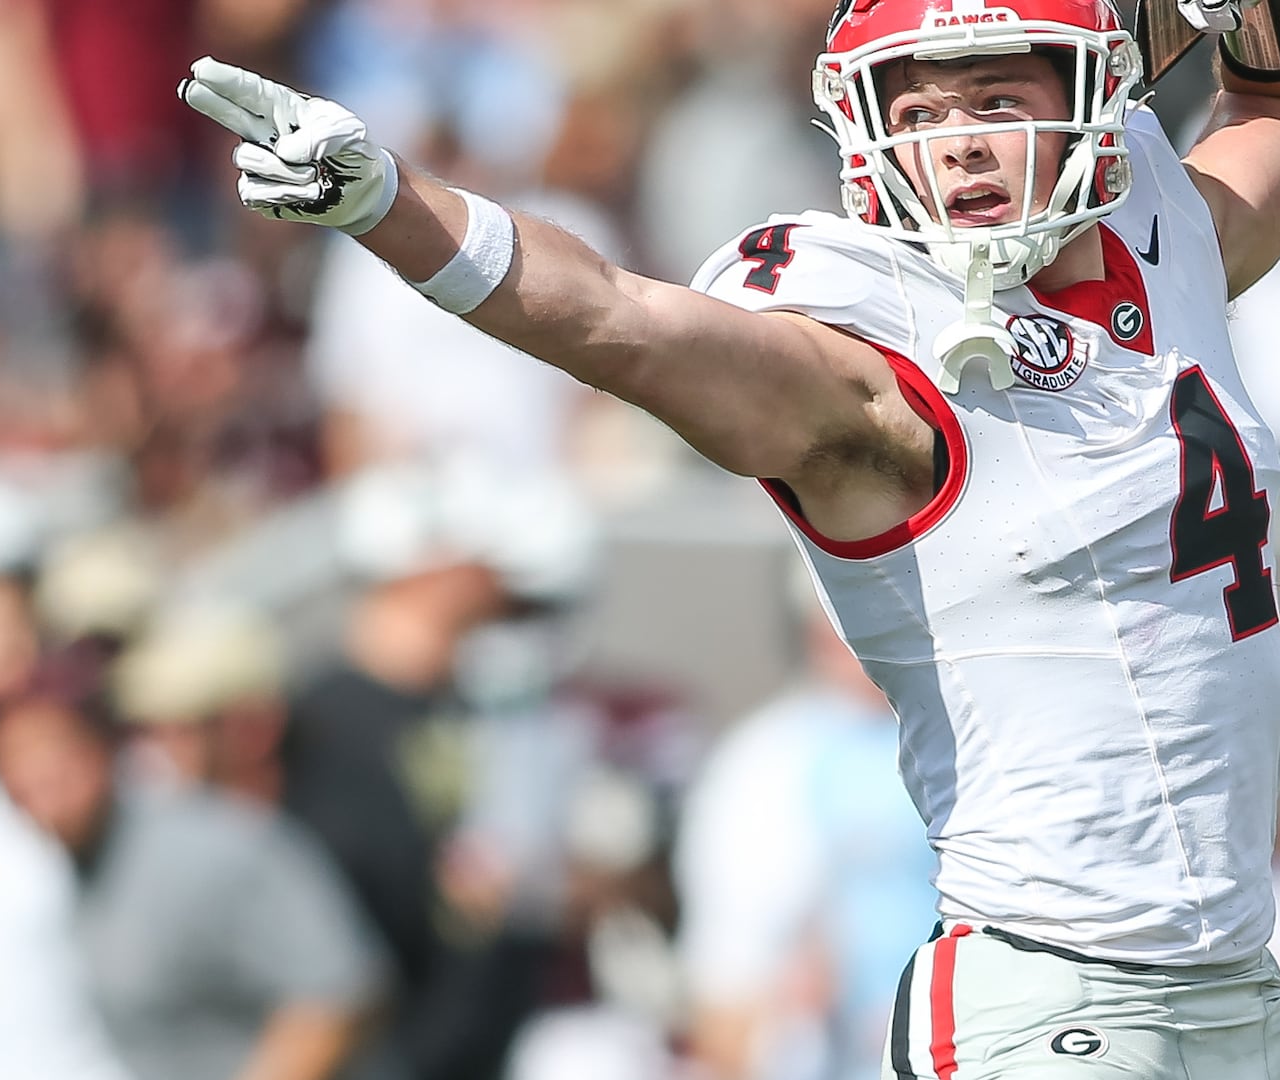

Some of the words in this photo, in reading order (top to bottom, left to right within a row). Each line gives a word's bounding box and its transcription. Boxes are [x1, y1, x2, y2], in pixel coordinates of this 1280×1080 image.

[934, 13, 1008, 27] DAWGS
[738, 223, 797, 295] 4
[1009, 316, 1068, 369] SEC
[1022, 356, 1084, 389] GRADUATE
[1170, 364, 1279, 642] 4
